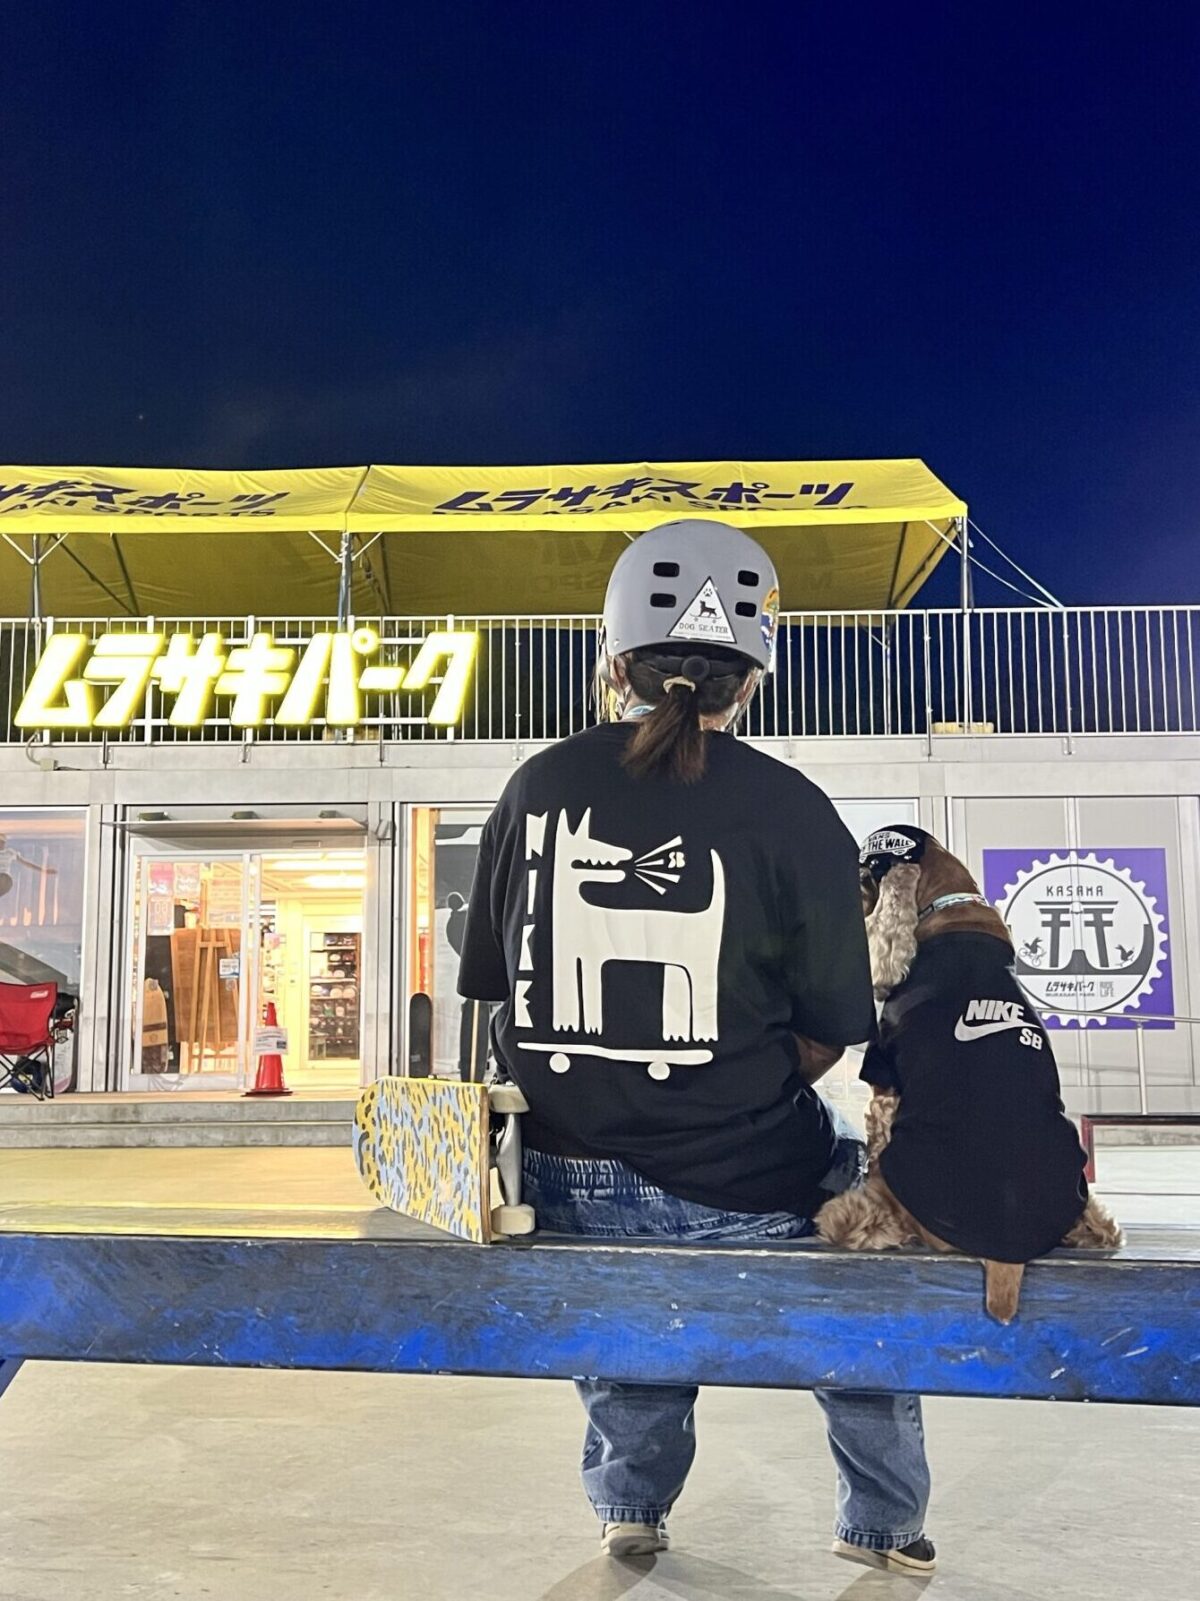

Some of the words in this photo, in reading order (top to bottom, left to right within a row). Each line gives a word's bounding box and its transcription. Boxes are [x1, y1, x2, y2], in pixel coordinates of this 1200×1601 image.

[434, 477, 855, 512] ムラサキスポーツ
[679, 622, 695, 631] DOG
[14, 631, 479, 727] ムラサキパーク
[667, 851, 686, 869] SB
[1046, 885, 1104, 897] KASAMA
[514, 811, 549, 1028] NIKE
[965, 999, 1025, 1023] NIKE
[1019, 1028, 1043, 1051] SB
